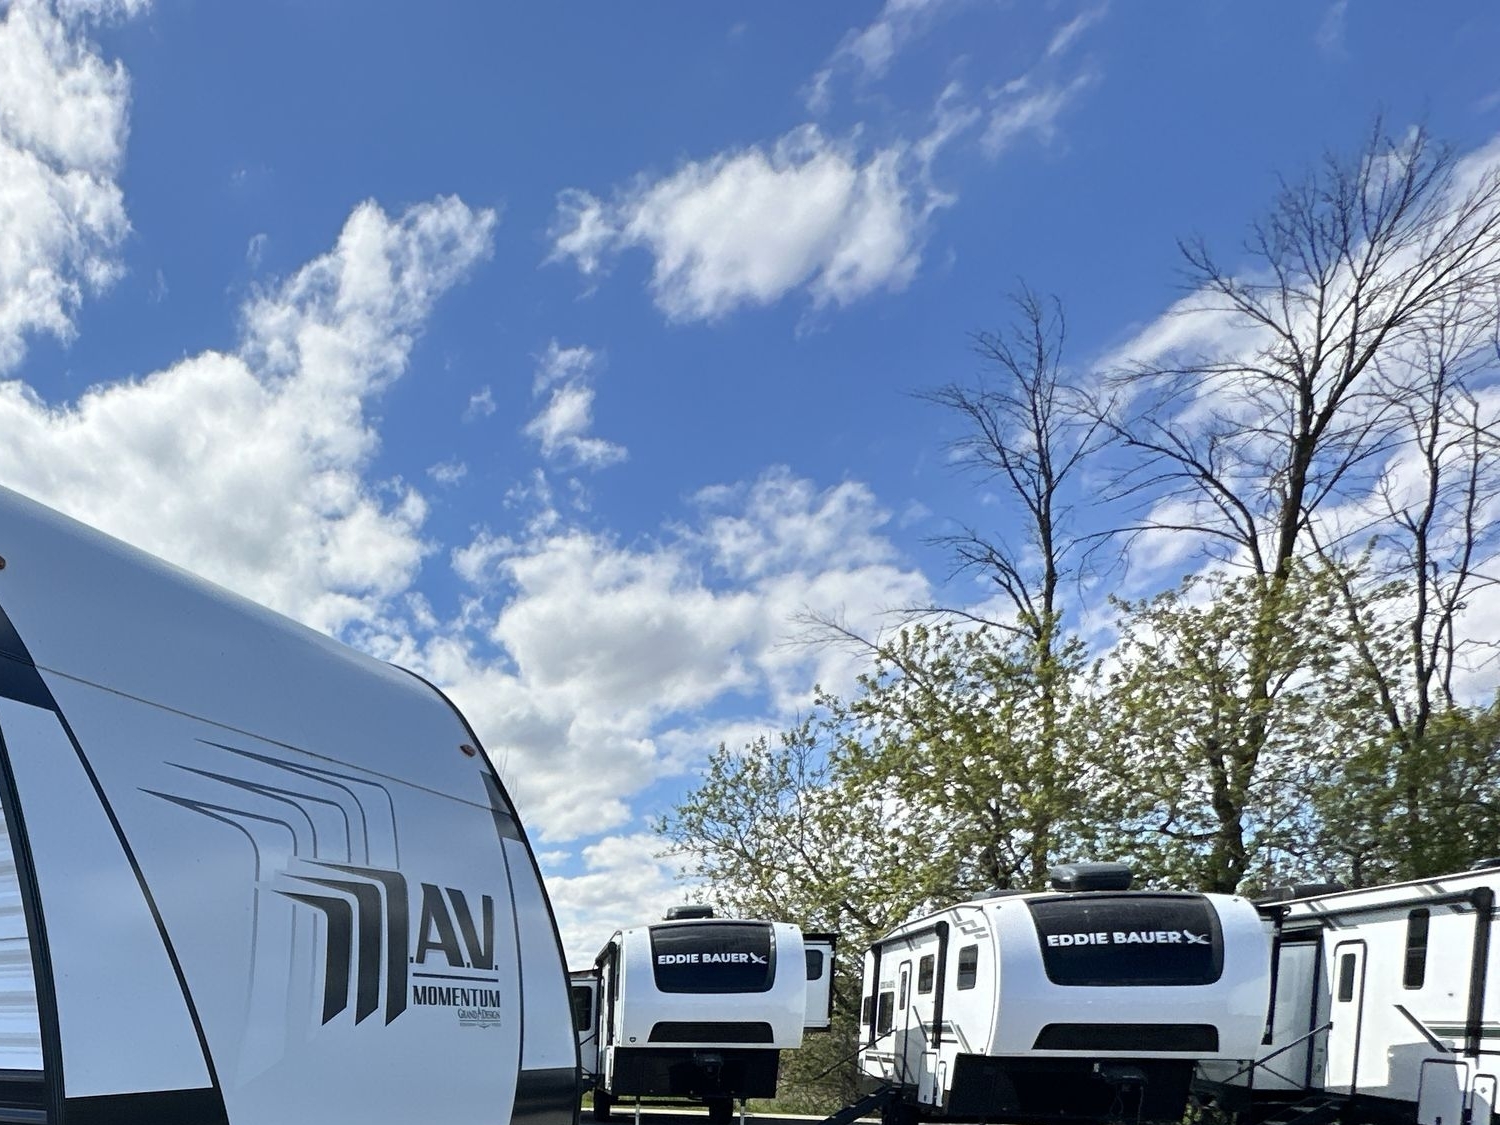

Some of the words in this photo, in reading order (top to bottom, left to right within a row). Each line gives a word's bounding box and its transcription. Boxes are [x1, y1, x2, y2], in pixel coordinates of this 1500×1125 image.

[1047, 932, 1108, 947] EDDIE
[1113, 931, 1182, 944] BAUER
[657, 954, 699, 965] EDDIE
[703, 953, 749, 963] BAUER
[413, 985, 500, 1007] MOMENTUM
